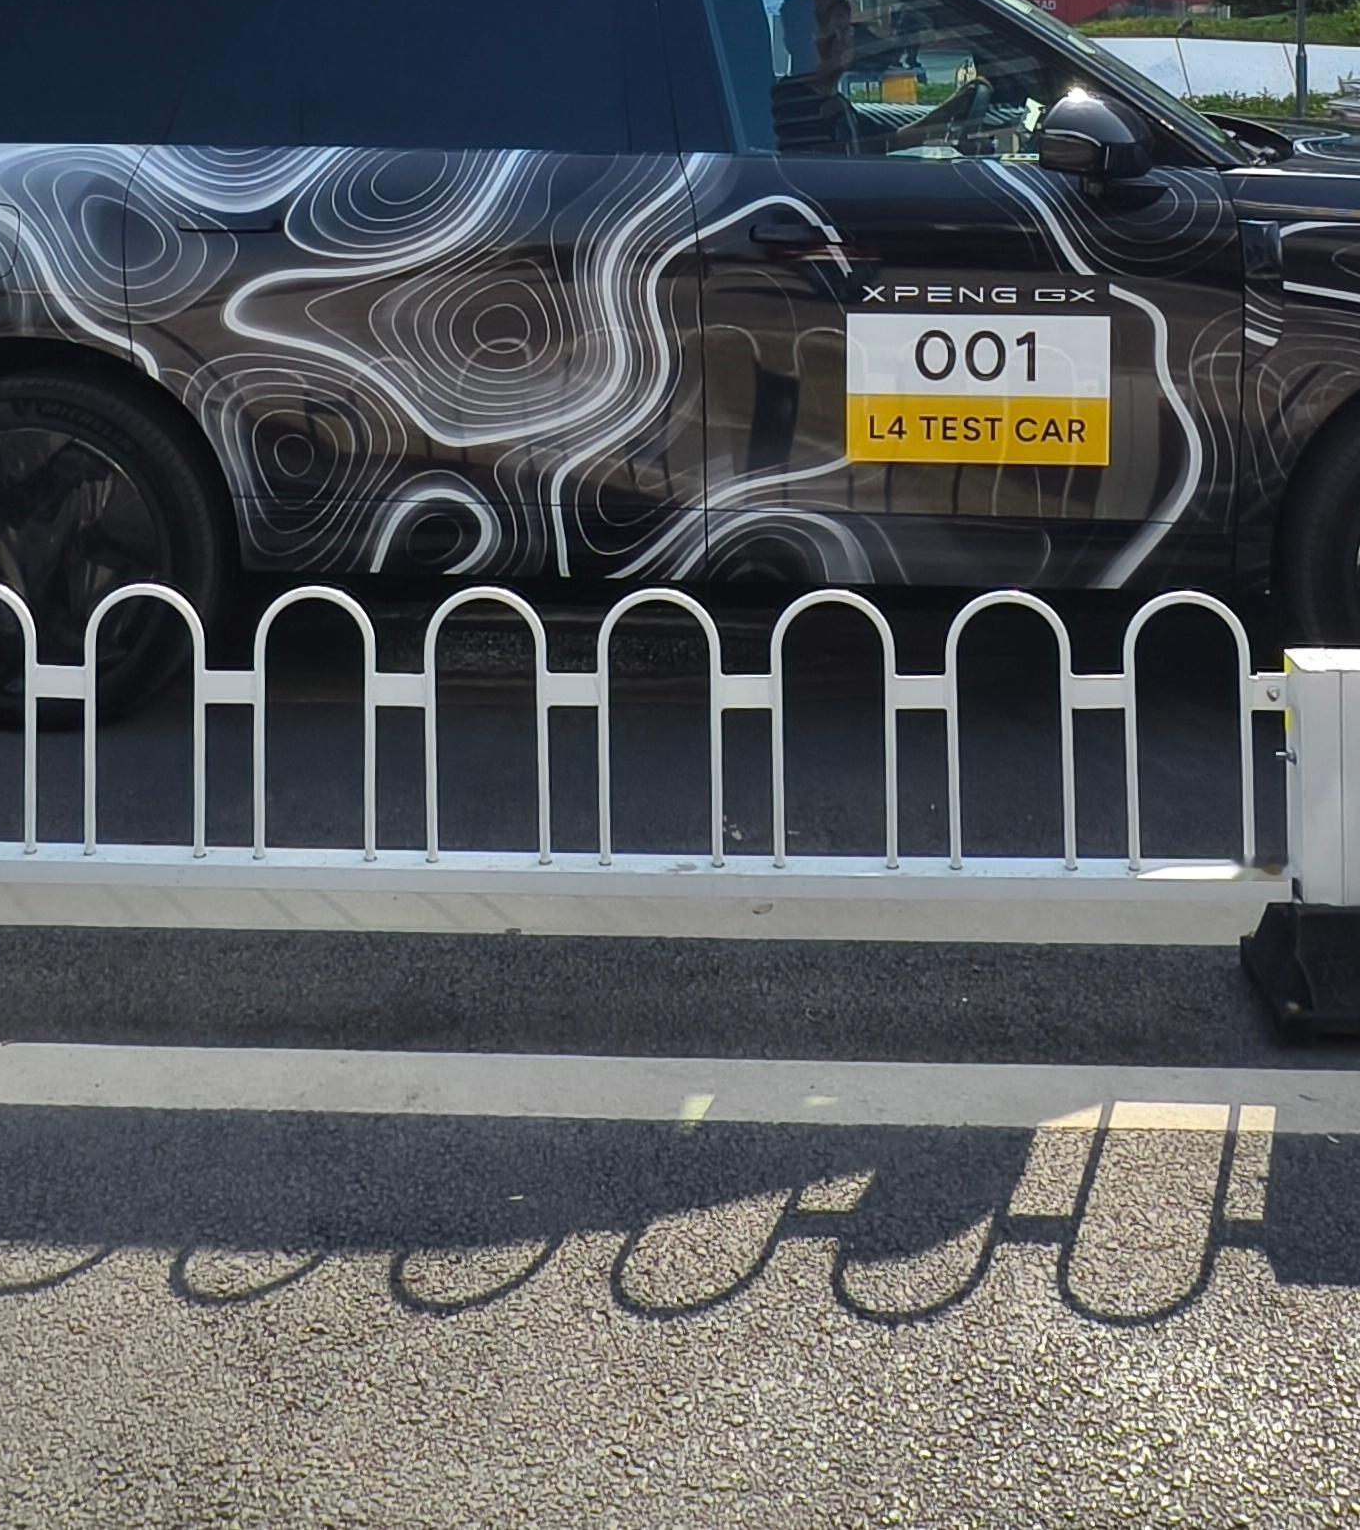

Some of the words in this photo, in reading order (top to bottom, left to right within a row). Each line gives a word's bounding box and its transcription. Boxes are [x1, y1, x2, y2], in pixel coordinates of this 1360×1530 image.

[861, 284, 1017, 303] XPENG
[1034, 288, 1096, 302] GX
[914, 329, 1037, 382] 001
[868, 415, 908, 441] L4
[918, 416, 1003, 442] TEST
[1014, 418, 1087, 443] CAR
